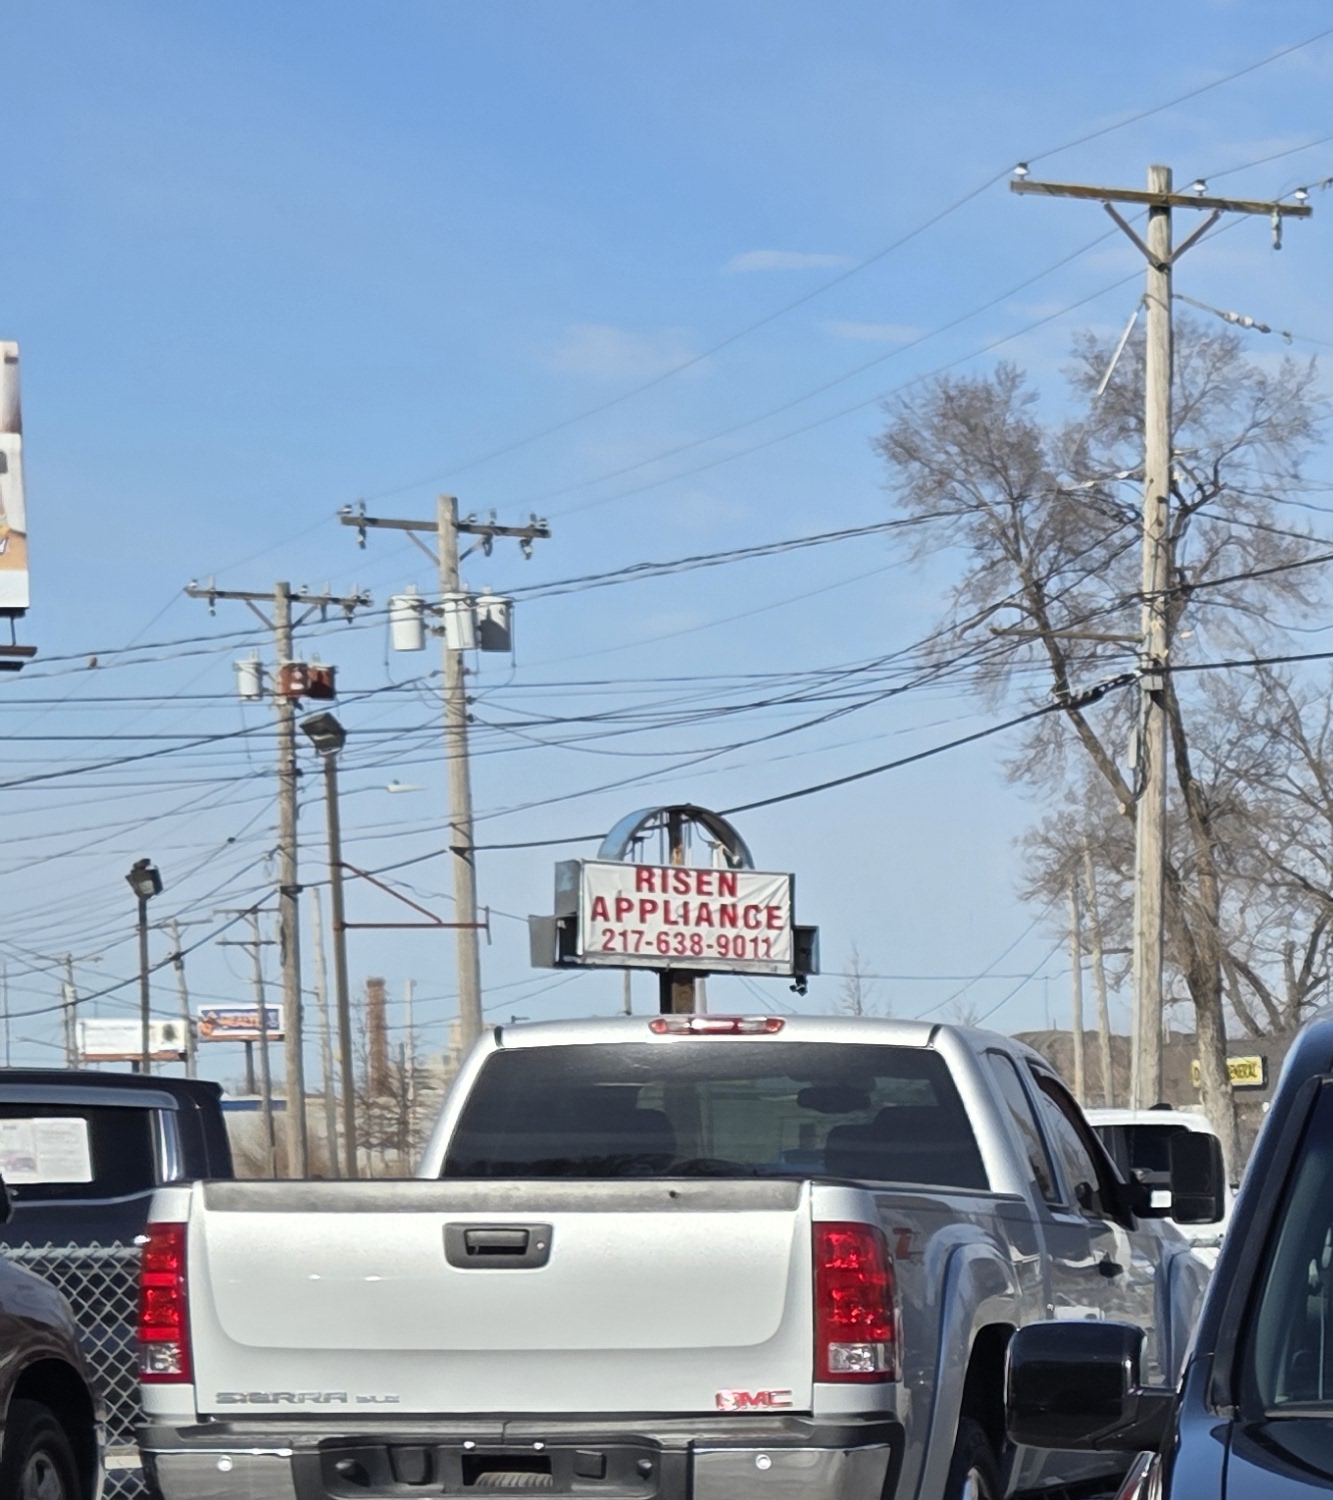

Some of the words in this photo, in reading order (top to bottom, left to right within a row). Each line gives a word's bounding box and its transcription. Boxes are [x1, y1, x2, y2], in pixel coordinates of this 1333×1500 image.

[635, 866, 738, 897] RISEN
[591, 896, 784, 930] APPLIANCE
[602, 928, 773, 959] 217-638-9011
[215, 1391, 348, 1404] SIERRA
[715, 1389, 793, 1410] GMC
